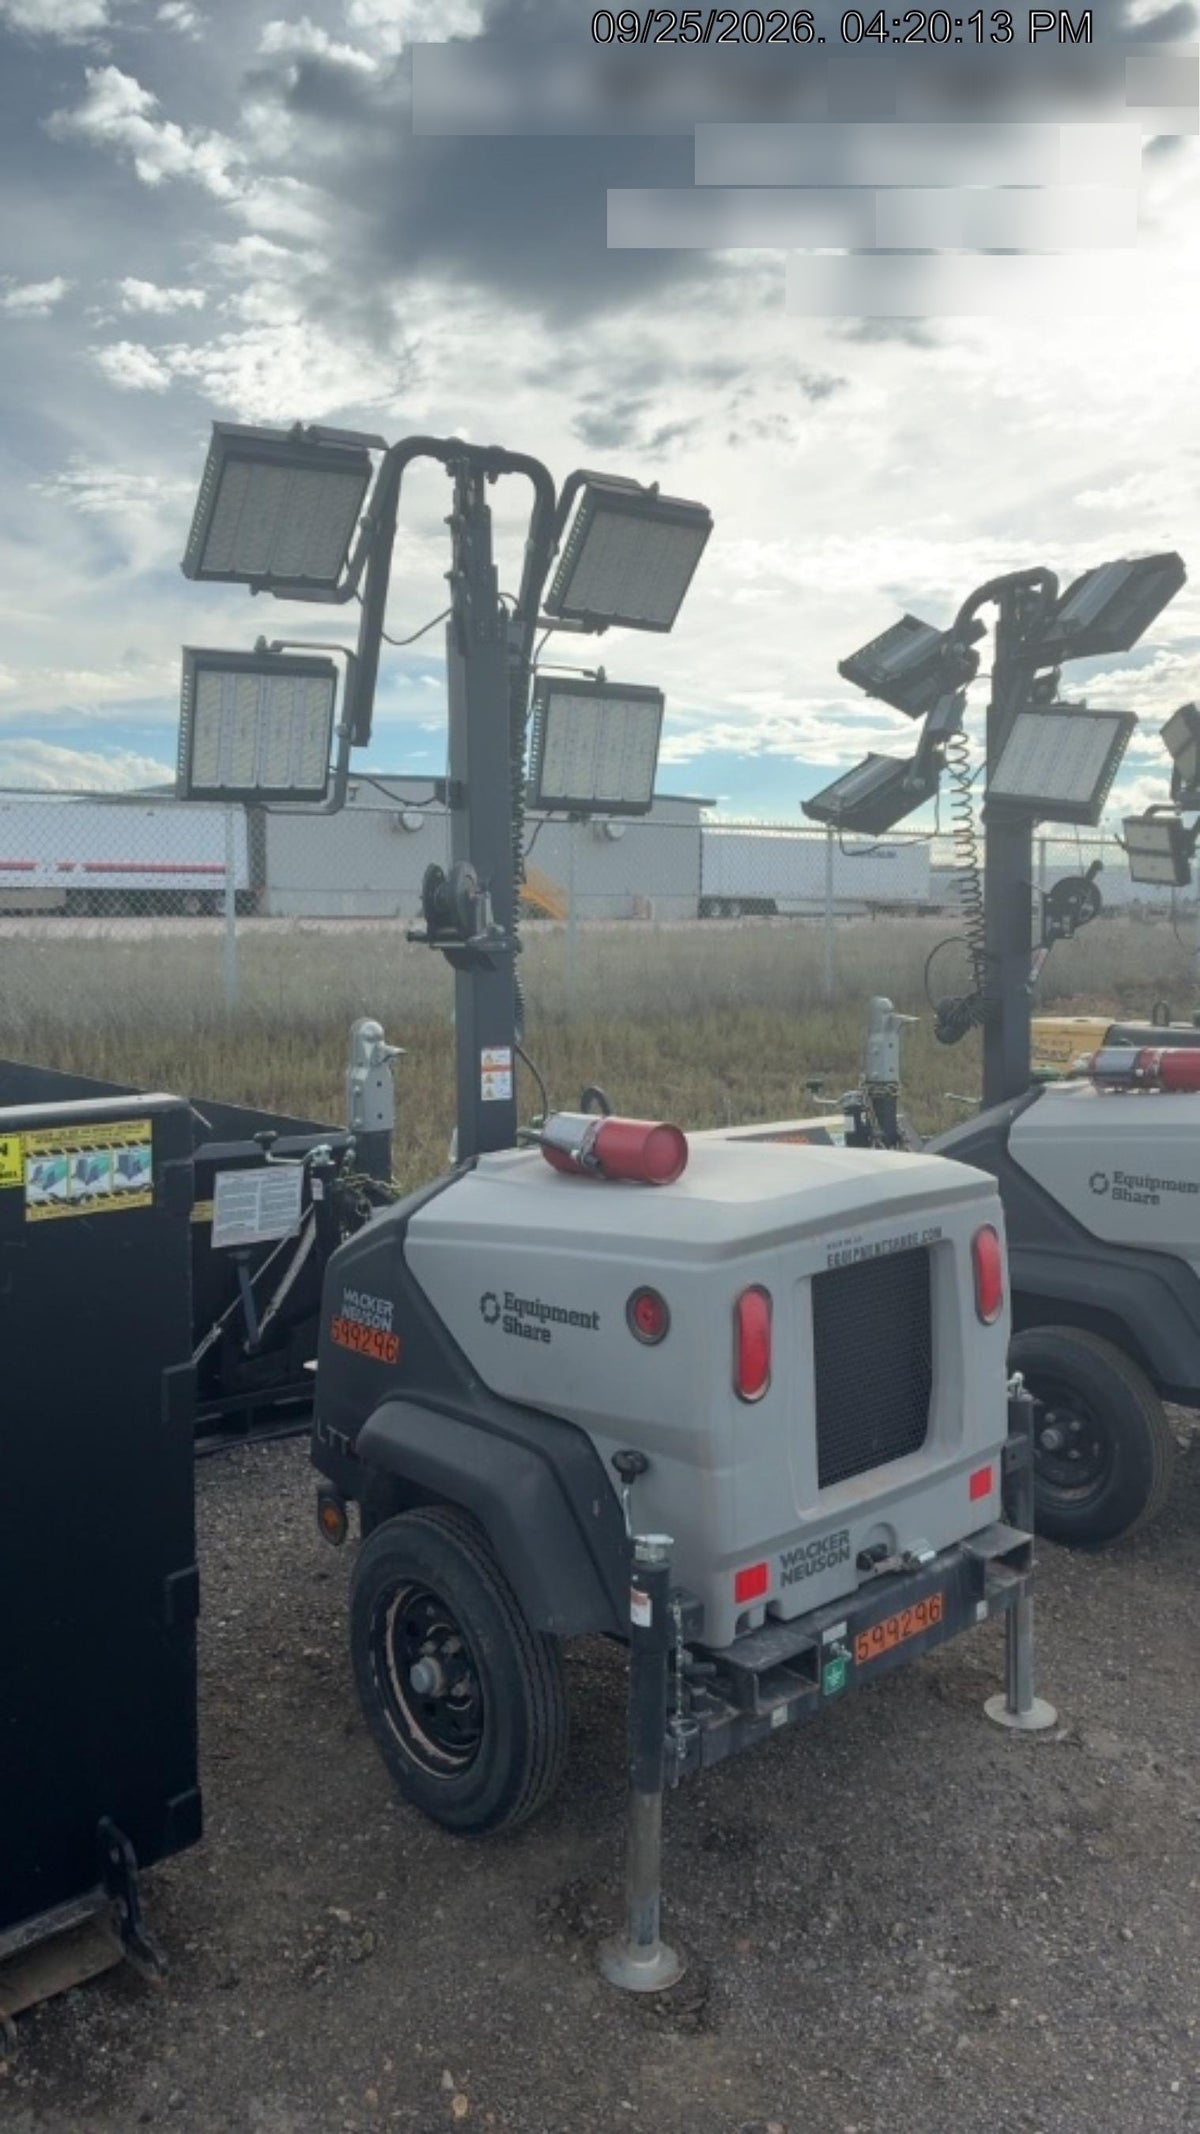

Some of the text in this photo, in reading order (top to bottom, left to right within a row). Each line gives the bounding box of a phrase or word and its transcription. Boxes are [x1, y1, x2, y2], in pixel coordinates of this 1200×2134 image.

[1111, 1187, 1160, 1205] Share
[1112, 1171, 1200, 1193] Equipmen
[343, 1287, 395, 1312] WACKER
[503, 1291, 601, 1330] Equipment
[331, 1317, 399, 1363] 599296
[502, 1315, 552, 1344] Share
[779, 1529, 850, 1567] WACKER
[780, 1546, 851, 1588] NEUSON
[857, 1595, 942, 1661] 599296
